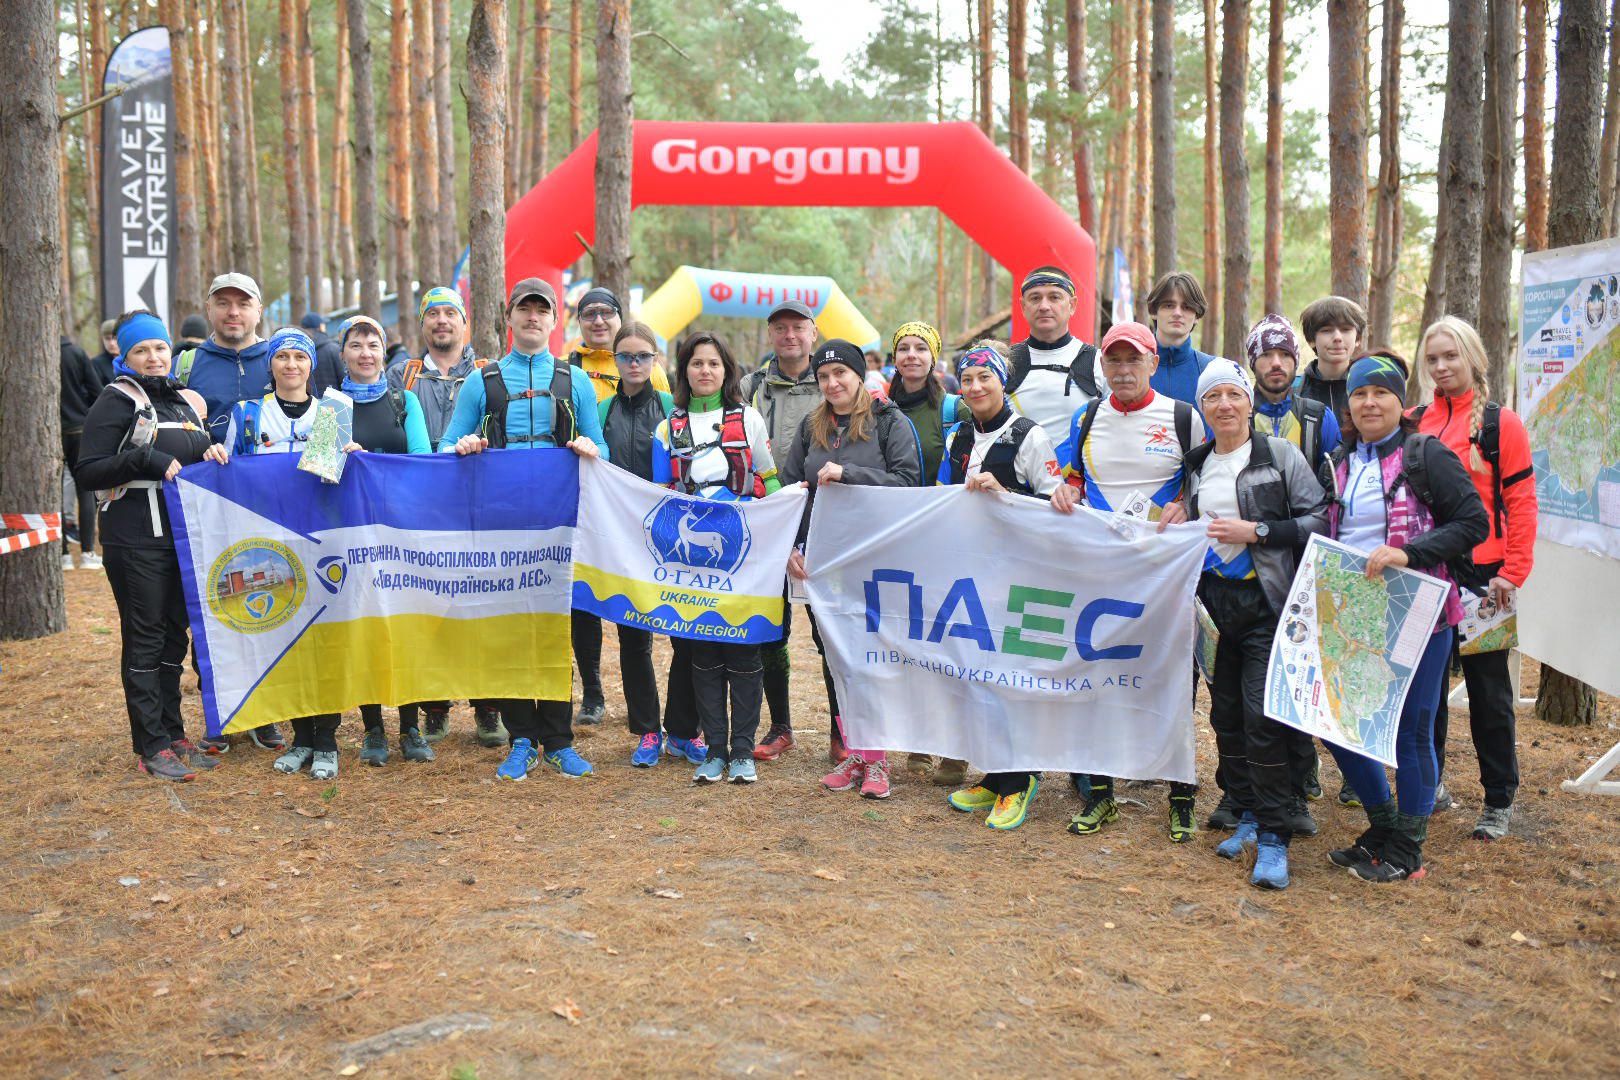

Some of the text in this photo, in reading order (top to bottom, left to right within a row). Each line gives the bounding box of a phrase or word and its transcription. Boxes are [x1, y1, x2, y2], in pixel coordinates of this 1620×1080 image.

[651, 139, 921, 184] Gorgany
[121, 101, 143, 255] TRAVEL
[145, 103, 168, 257] EXTREME
[709, 282, 819, 308] ФІНІШ
[347, 545, 572, 568] ПЕРВИННА ПРОФСПІЛКОВА ОРГАНІЗАЦІЯ
[518, 568, 552, 590] АЕС»
[660, 590, 719, 608] UKRAINE
[623, 610, 749, 639] MYKOLAIV REGION
[863, 568, 1145, 662] ПАЕС
[1102, 674, 1143, 689] АЕС
